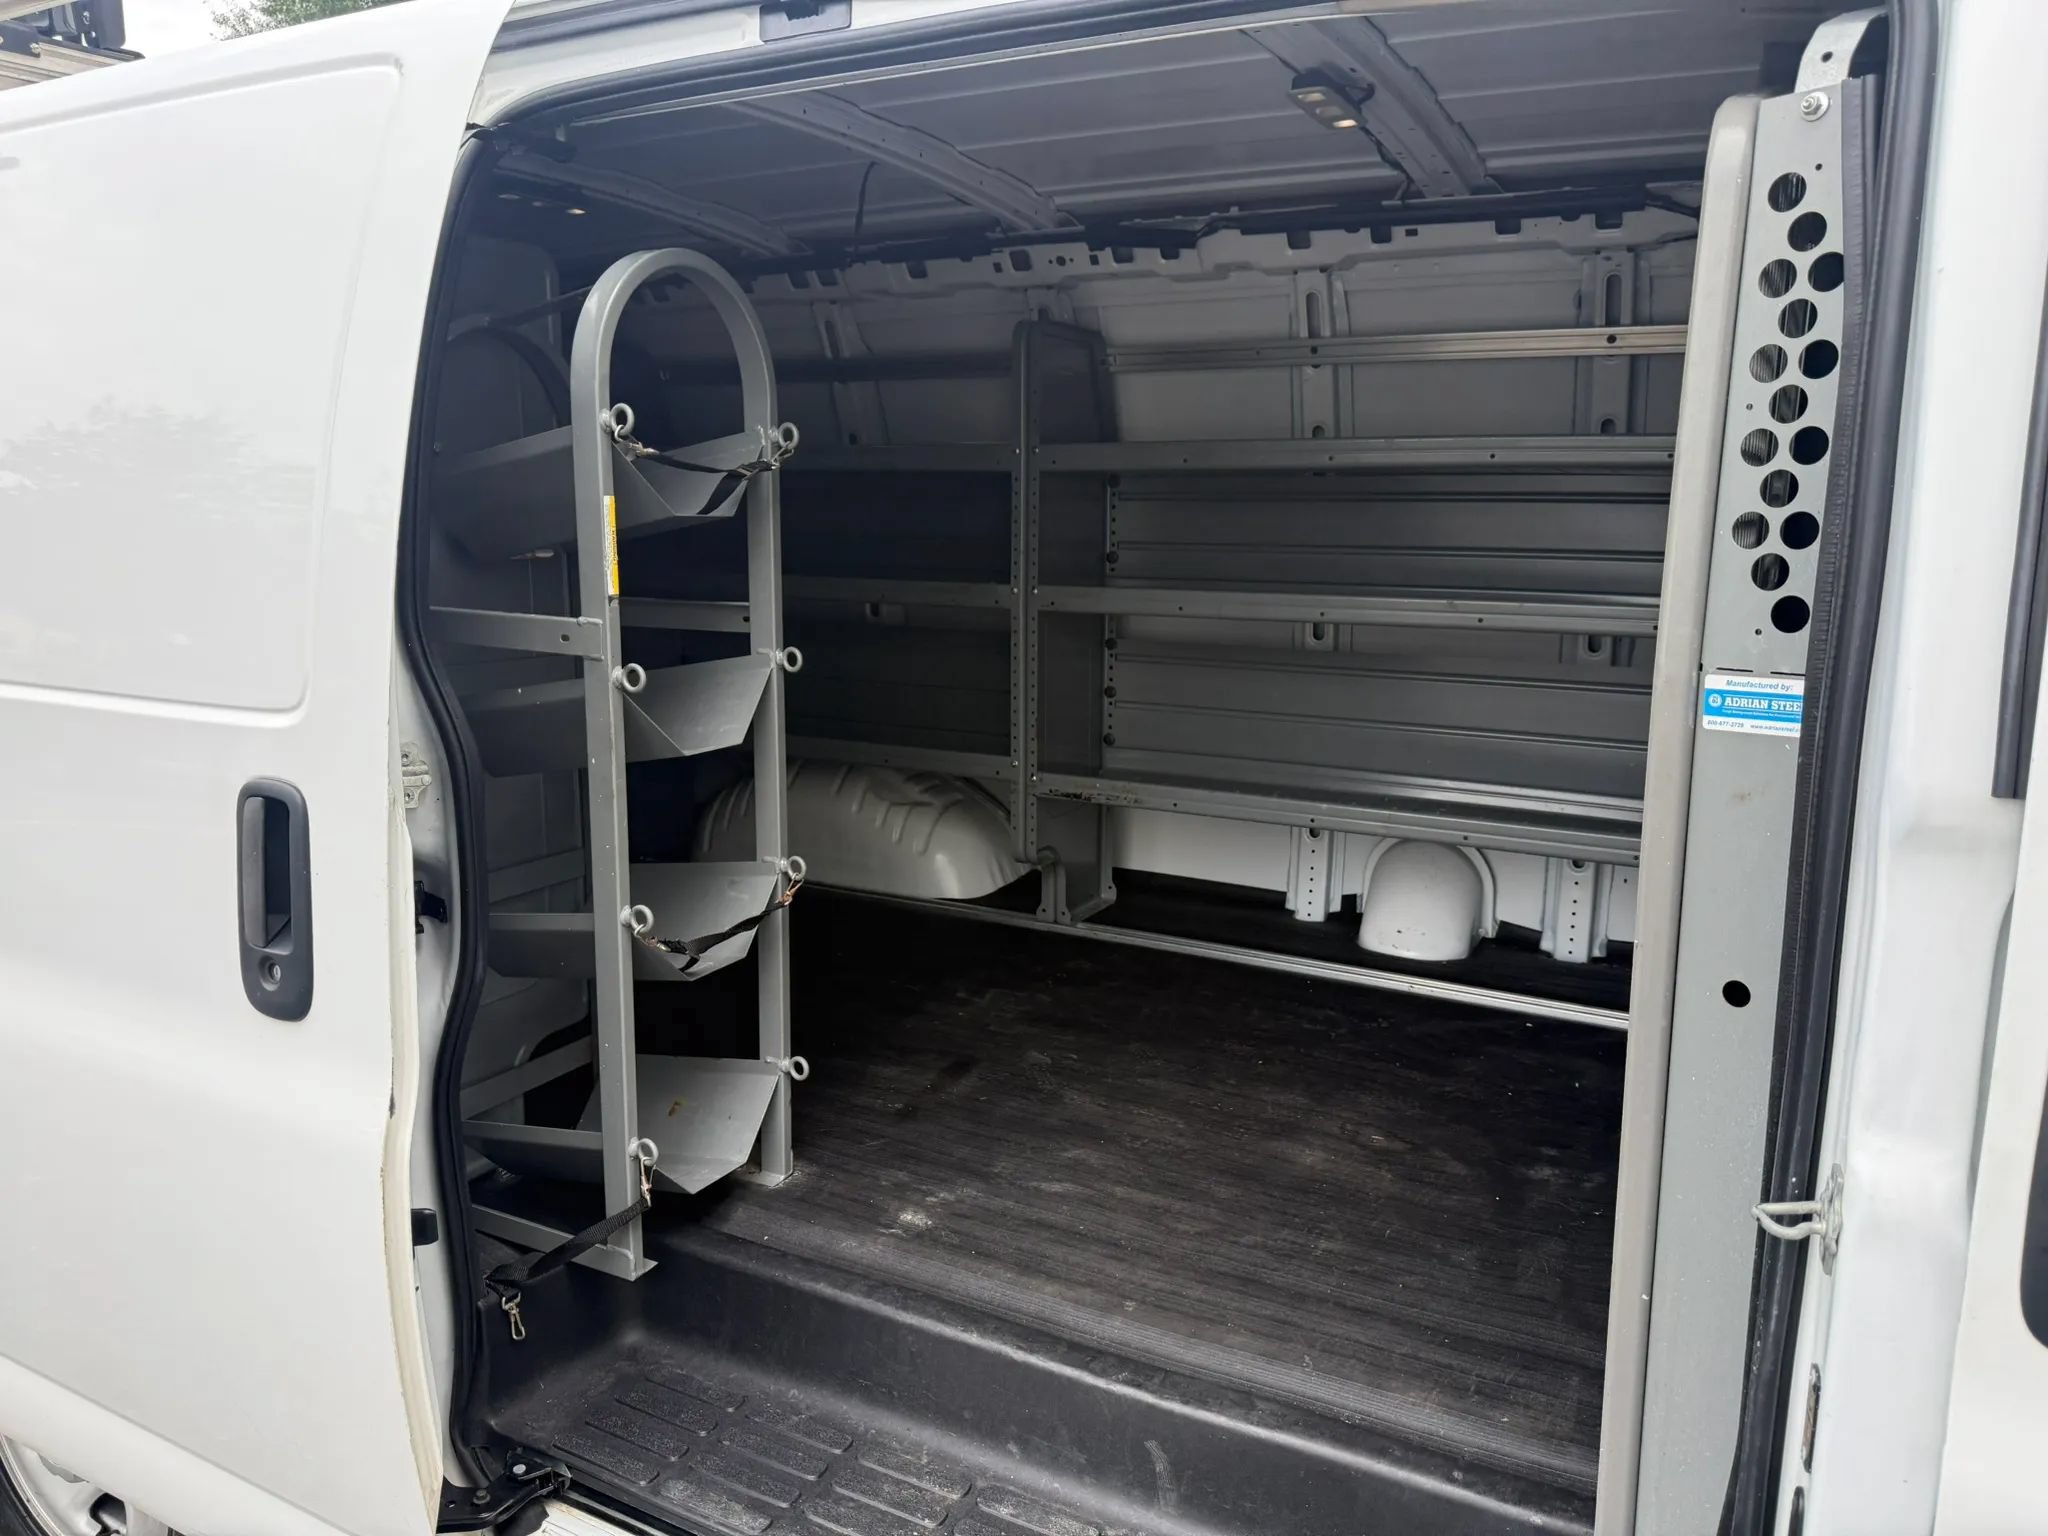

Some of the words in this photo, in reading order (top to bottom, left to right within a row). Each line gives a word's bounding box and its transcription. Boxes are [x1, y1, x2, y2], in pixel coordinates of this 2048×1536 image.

[1726, 680, 1779, 690] Manufactured
[1780, 684, 1793, 692] by:
[1724, 697, 1768, 709] ADRIAN
